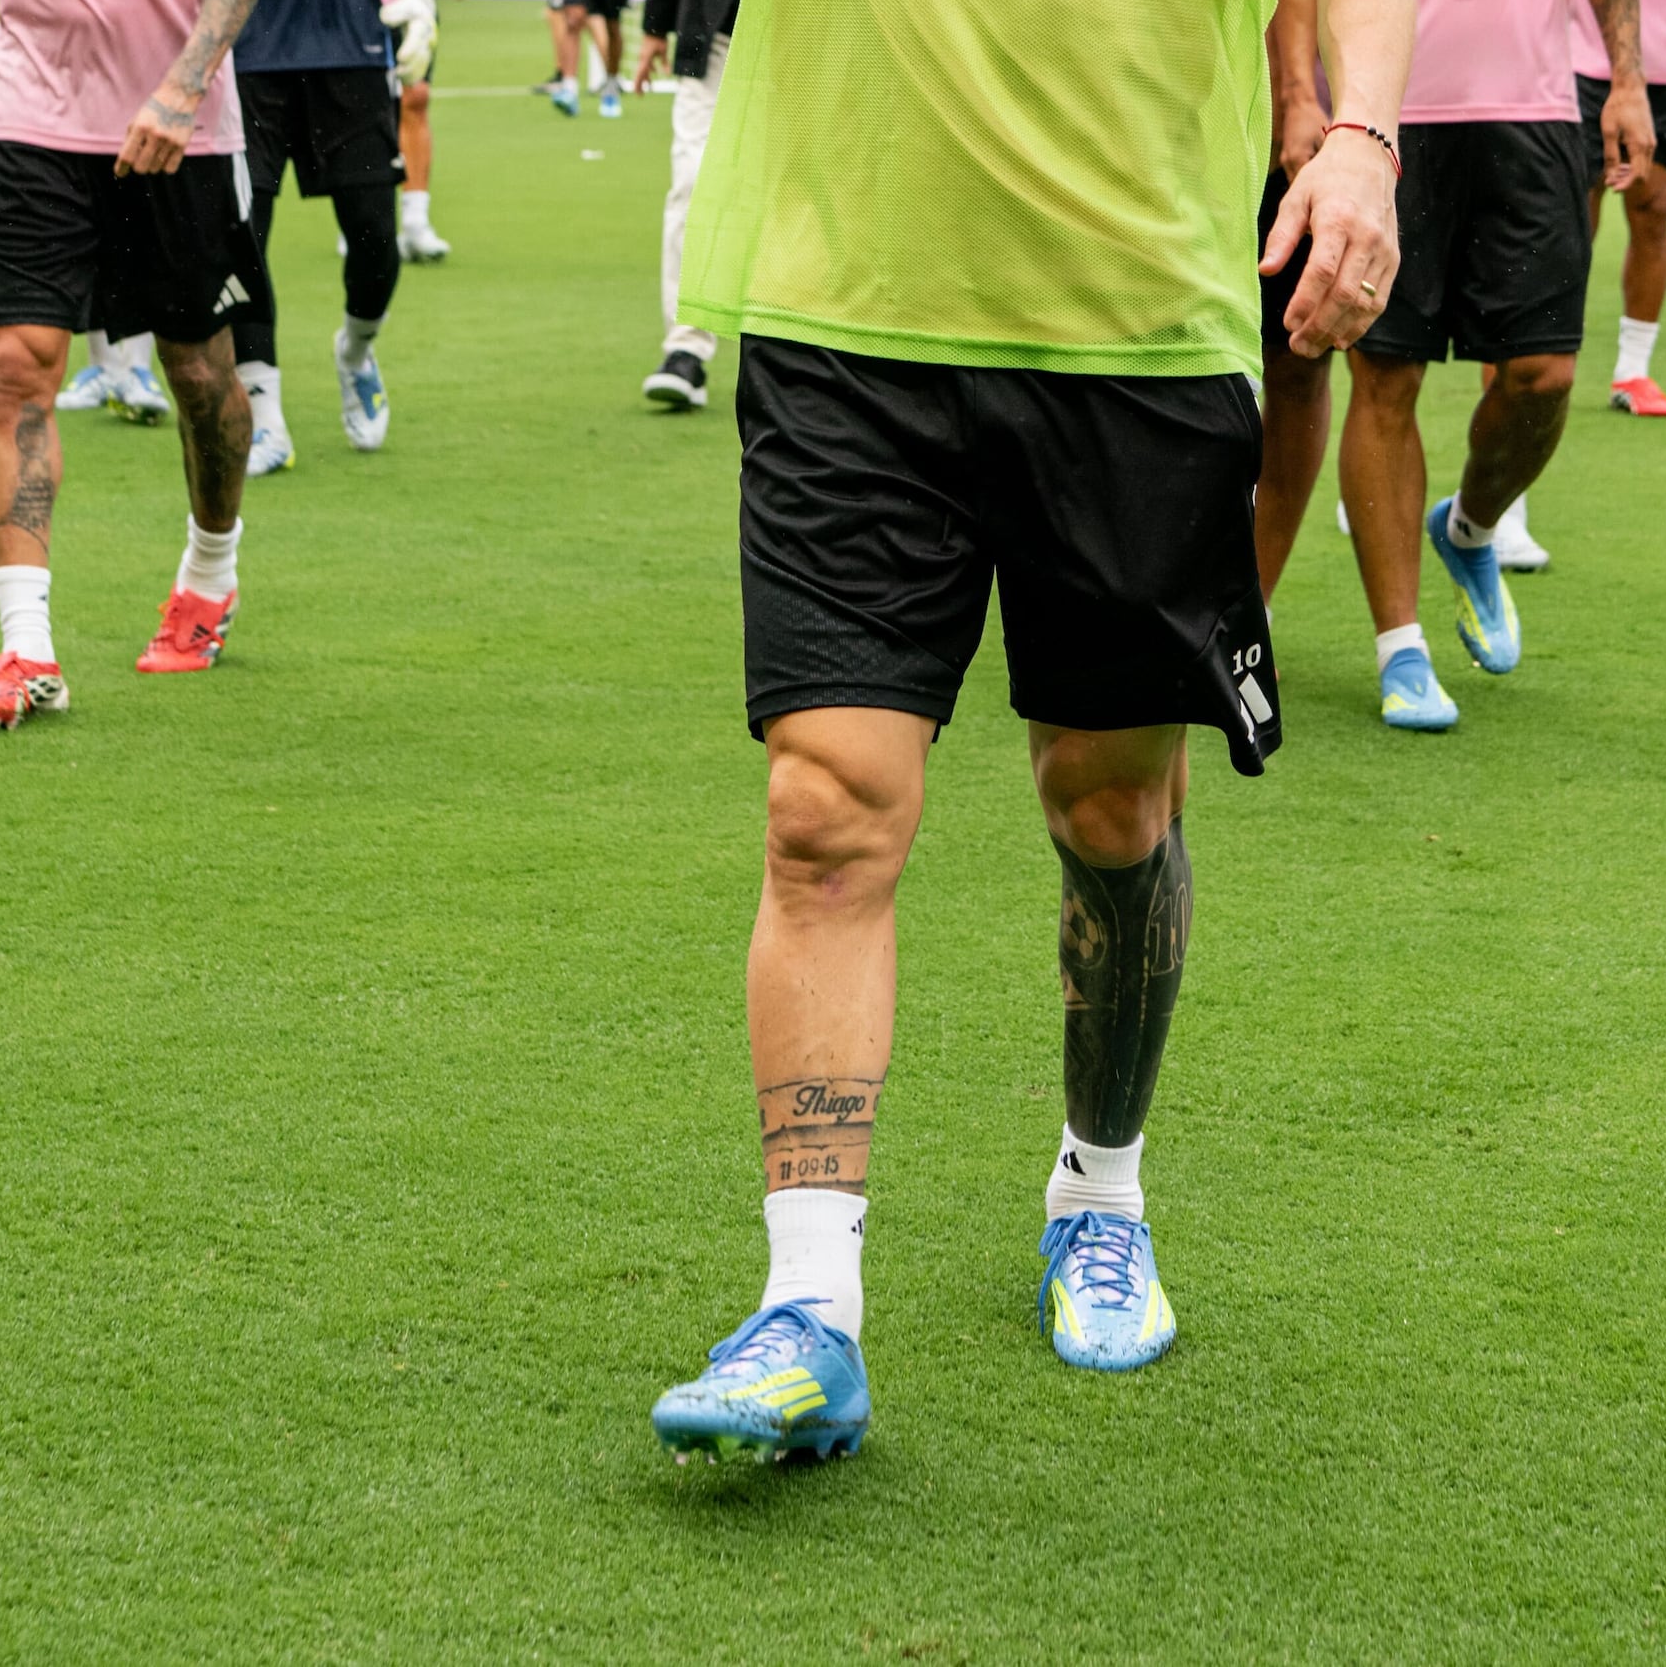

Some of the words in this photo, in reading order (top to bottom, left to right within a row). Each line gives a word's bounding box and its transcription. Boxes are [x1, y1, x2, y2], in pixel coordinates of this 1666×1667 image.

[1232, 642, 1263, 676] 10
[1150, 882, 1190, 976] 10
[792, 1084, 867, 1123] Thiago
